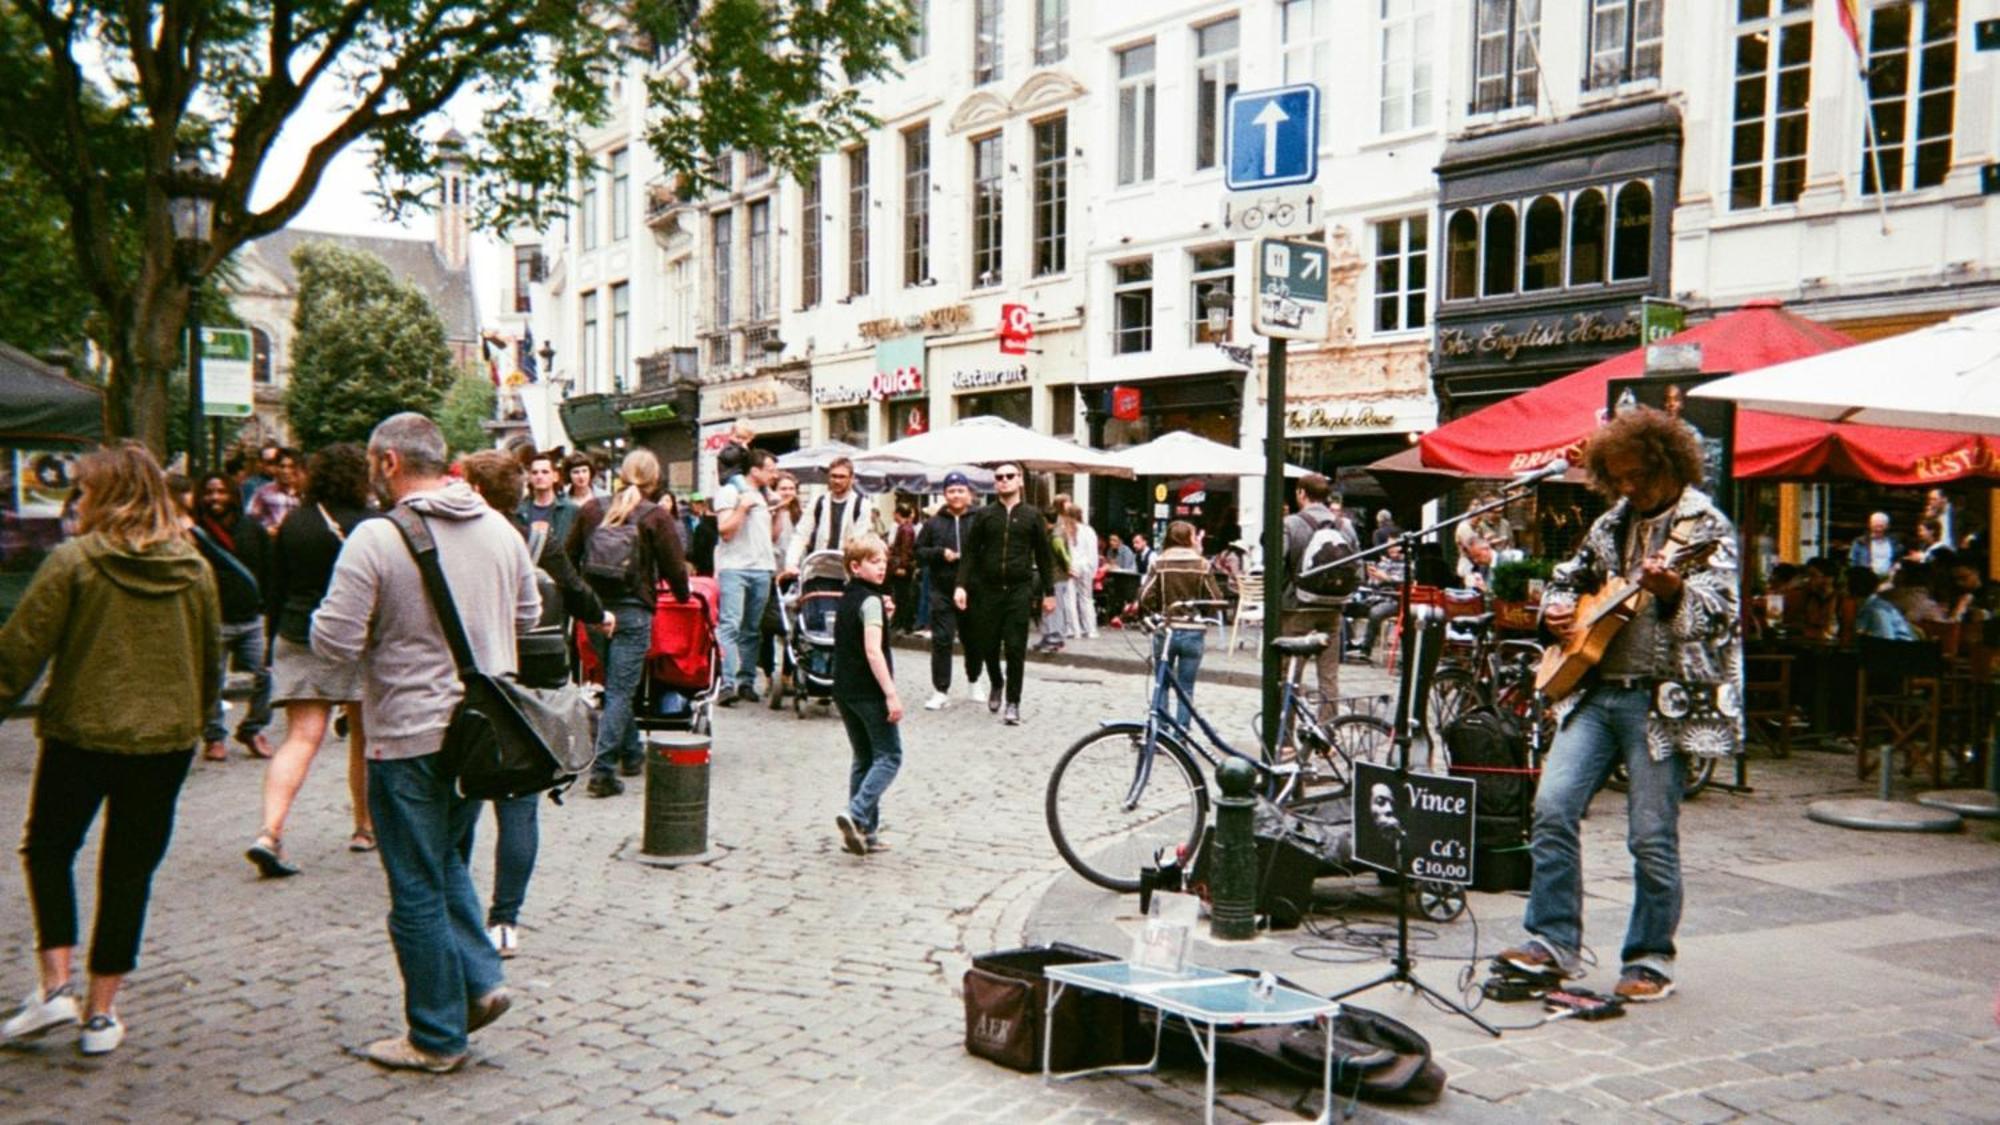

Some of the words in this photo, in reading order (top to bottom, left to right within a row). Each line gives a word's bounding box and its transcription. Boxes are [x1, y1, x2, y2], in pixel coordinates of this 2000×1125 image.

[1009, 307, 1029, 334] Q
[1439, 327, 1473, 356] The
[1479, 318, 1565, 360] English
[1567, 309, 1642, 342] House
[868, 367, 923, 401] Quick
[1403, 782, 1466, 815] Vince
[1430, 840, 1466, 859] Cd's
[1411, 857, 1467, 878] €10,00
